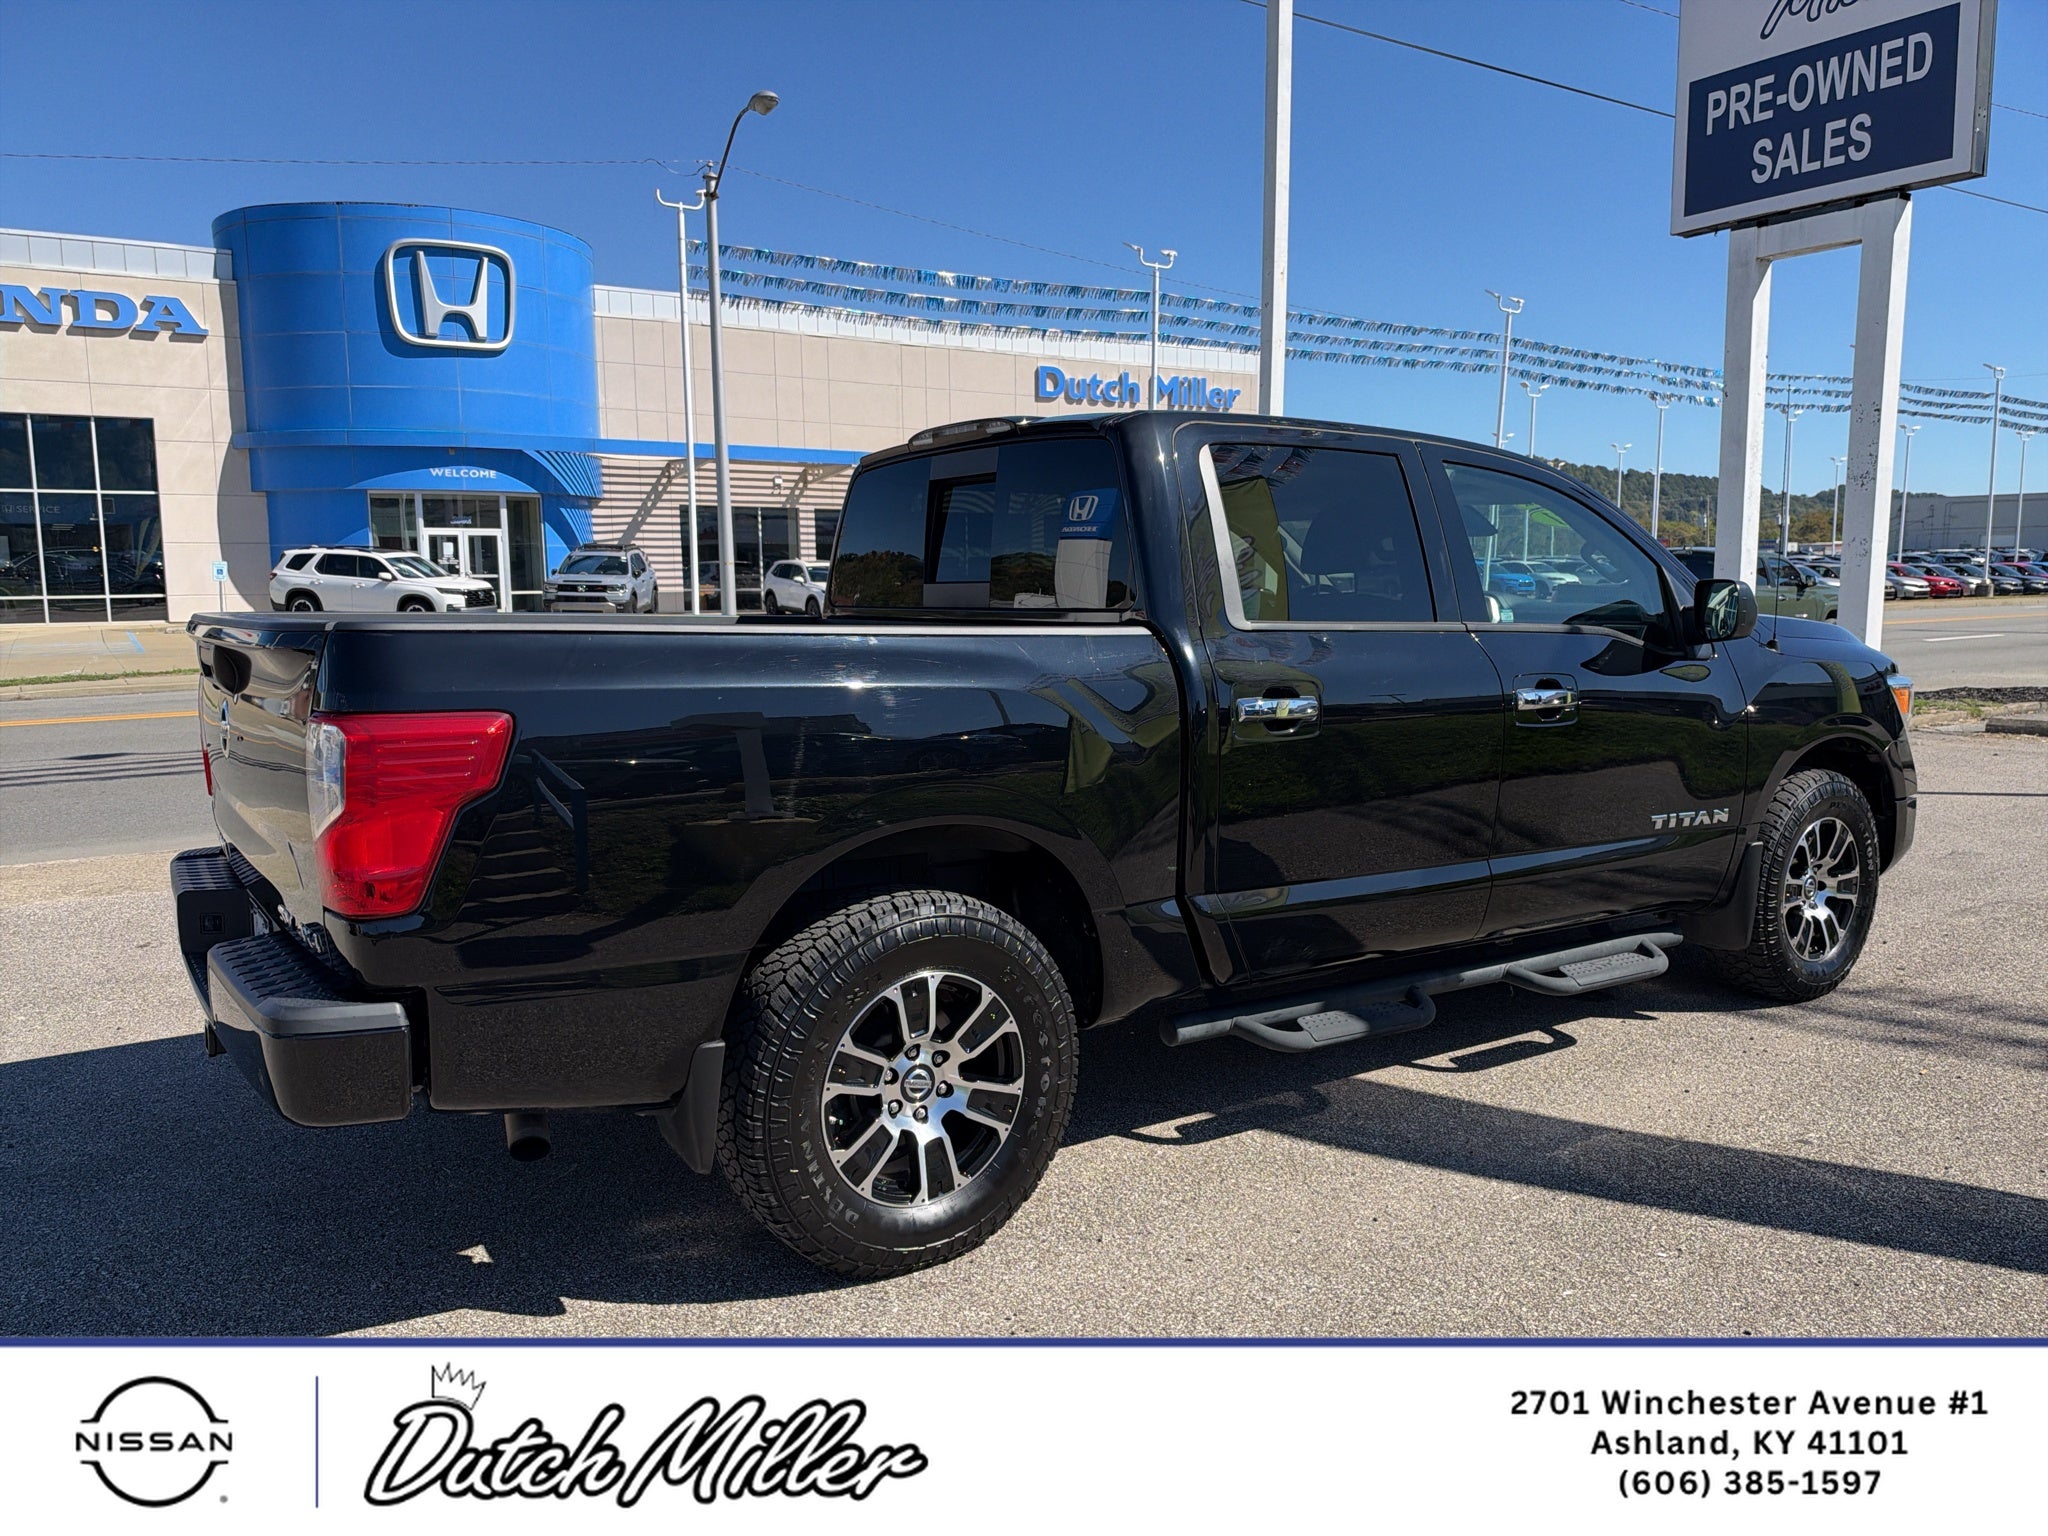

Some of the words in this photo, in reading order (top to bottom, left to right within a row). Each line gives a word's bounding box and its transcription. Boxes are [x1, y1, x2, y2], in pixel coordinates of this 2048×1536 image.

[1706, 32, 1933, 136] PRE-OWNED
[1751, 113, 1872, 183] SALES
[1037, 366, 1141, 403] Dutch
[1152, 374, 1241, 409] Miller
[430, 468, 497, 479] WELCOME
[1651, 808, 1729, 830] TITAN
